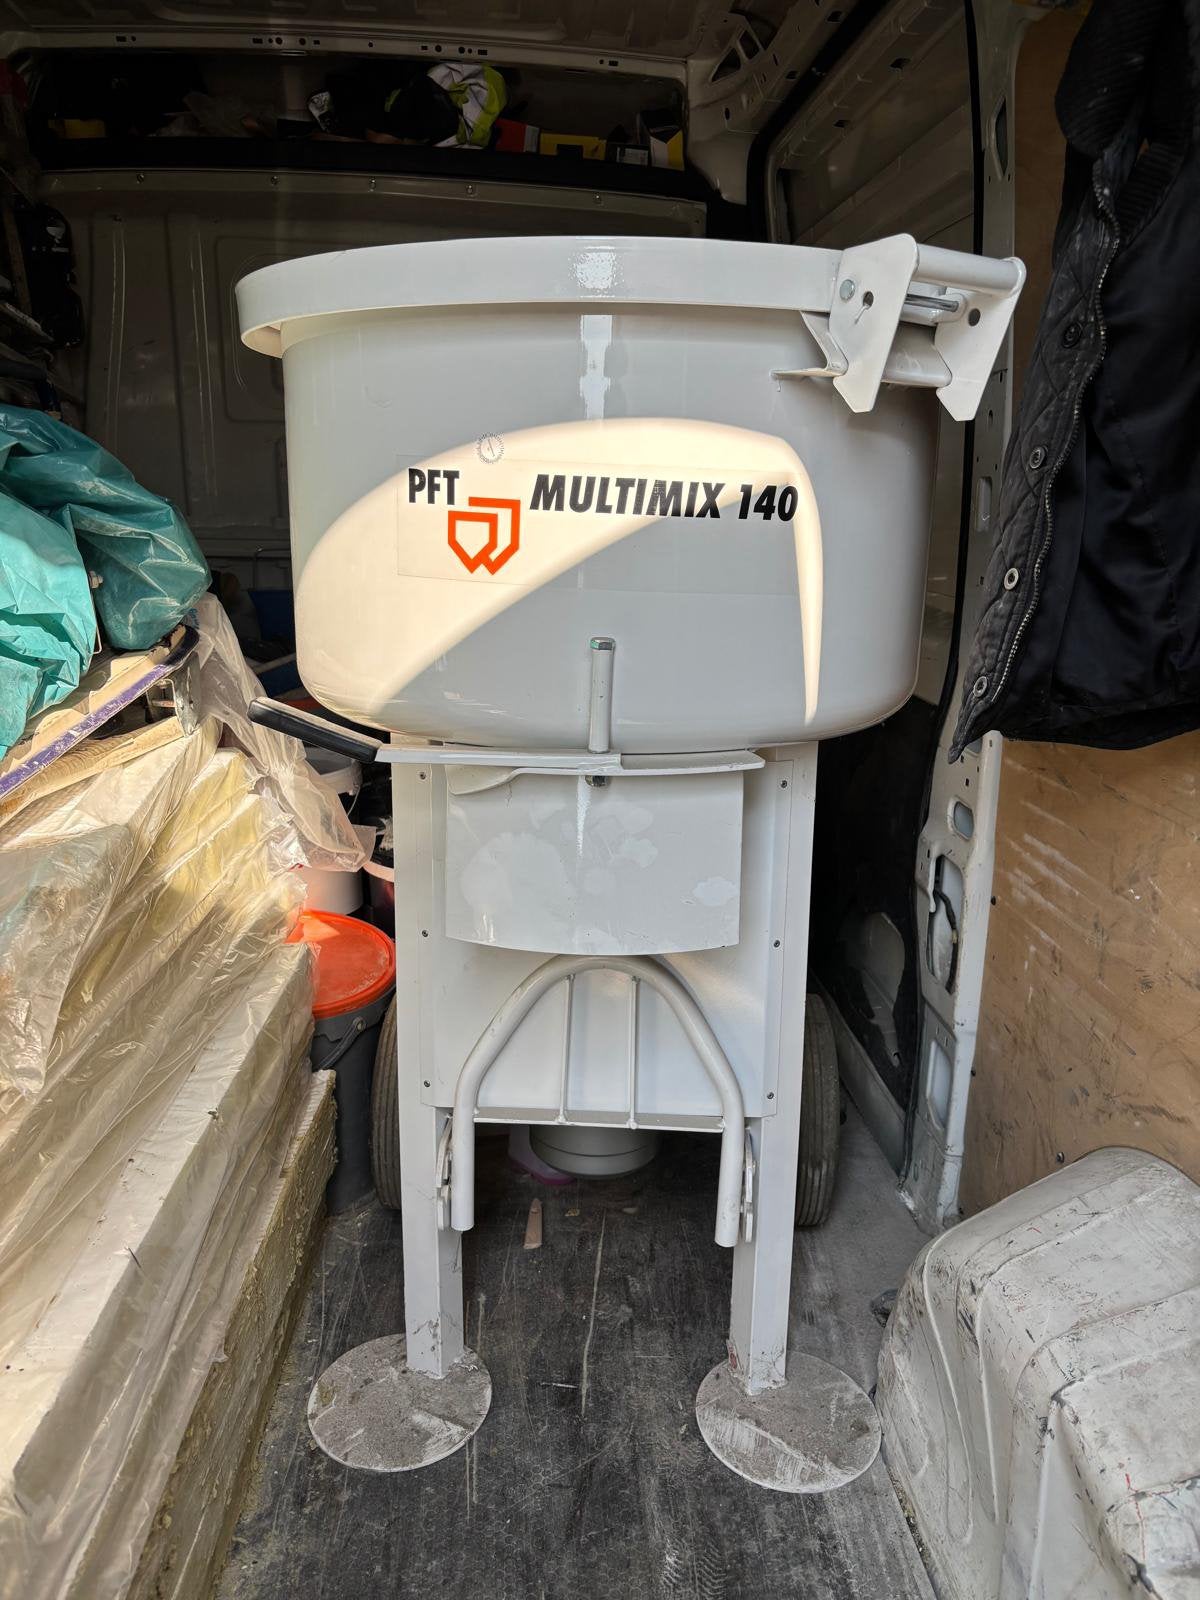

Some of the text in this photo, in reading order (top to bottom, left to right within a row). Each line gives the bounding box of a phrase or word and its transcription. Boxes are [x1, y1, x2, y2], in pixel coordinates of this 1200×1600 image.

[408, 467, 799, 522] PFT MULTIMIX 140
